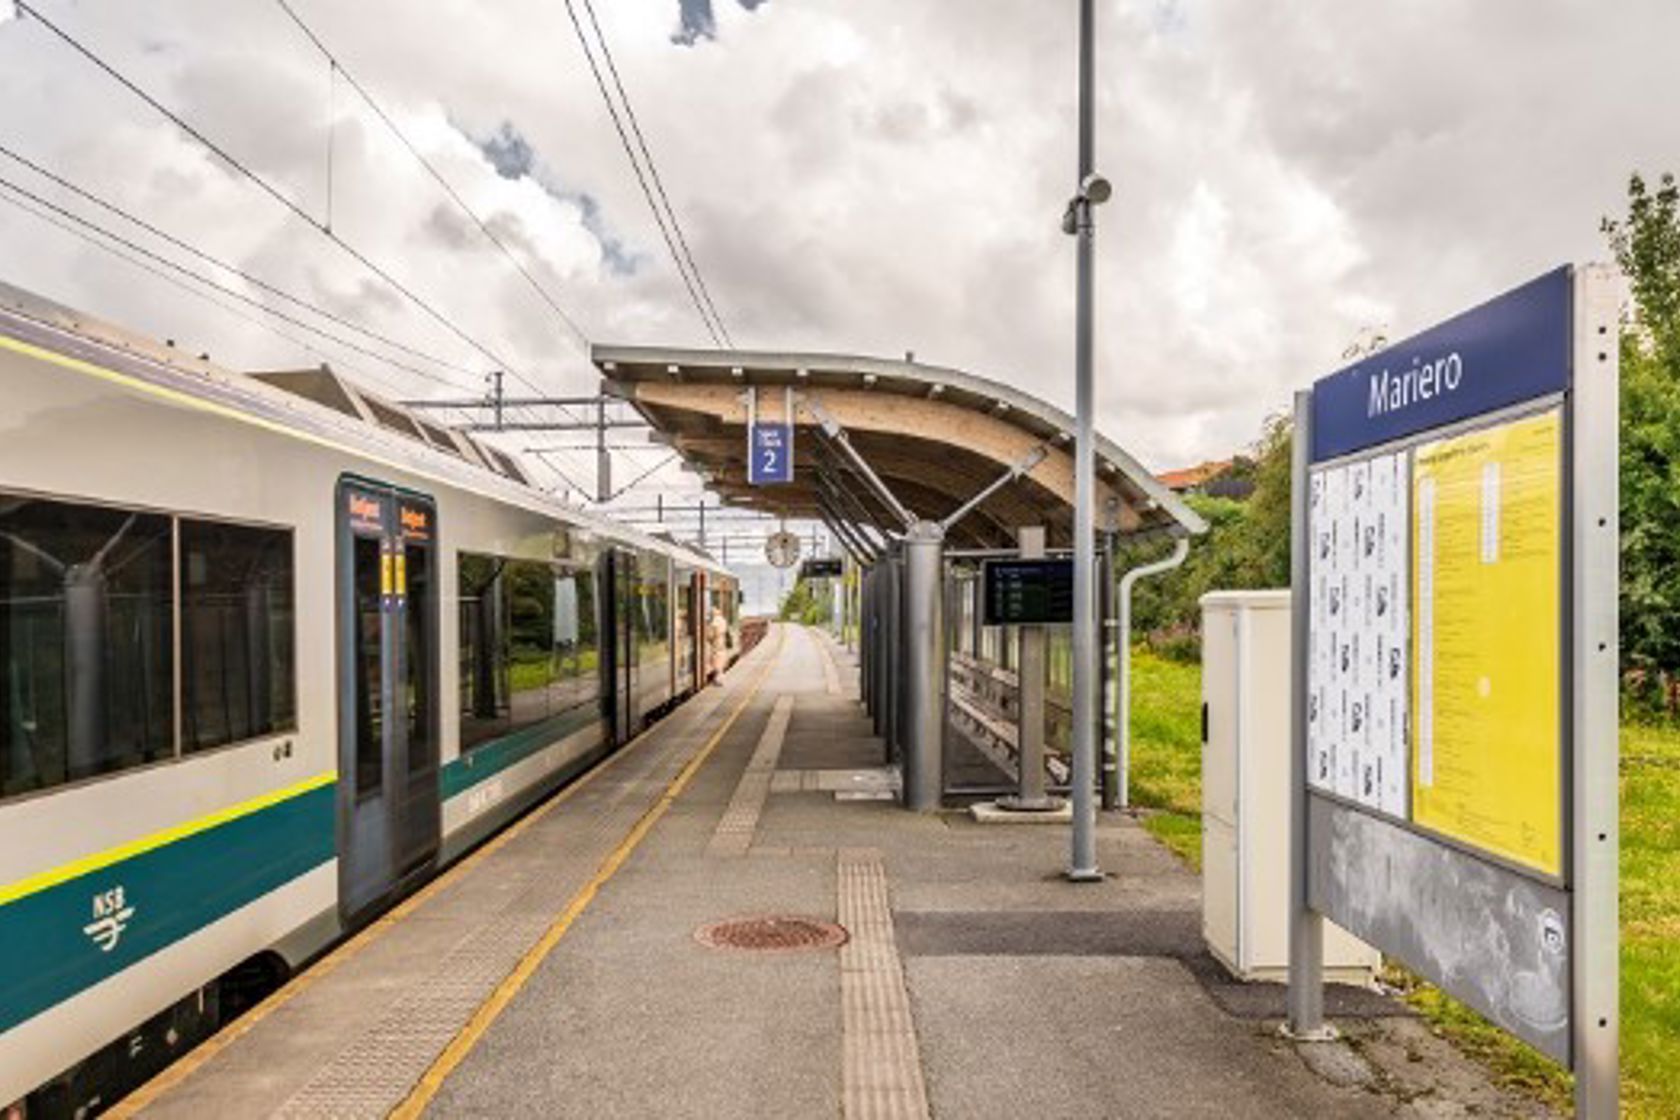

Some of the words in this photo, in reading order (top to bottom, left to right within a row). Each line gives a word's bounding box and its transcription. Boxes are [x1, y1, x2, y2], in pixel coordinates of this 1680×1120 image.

[1367, 352, 1462, 418] Mariero
[762, 449, 777, 473] 2
[93, 886, 125, 918] NSB
